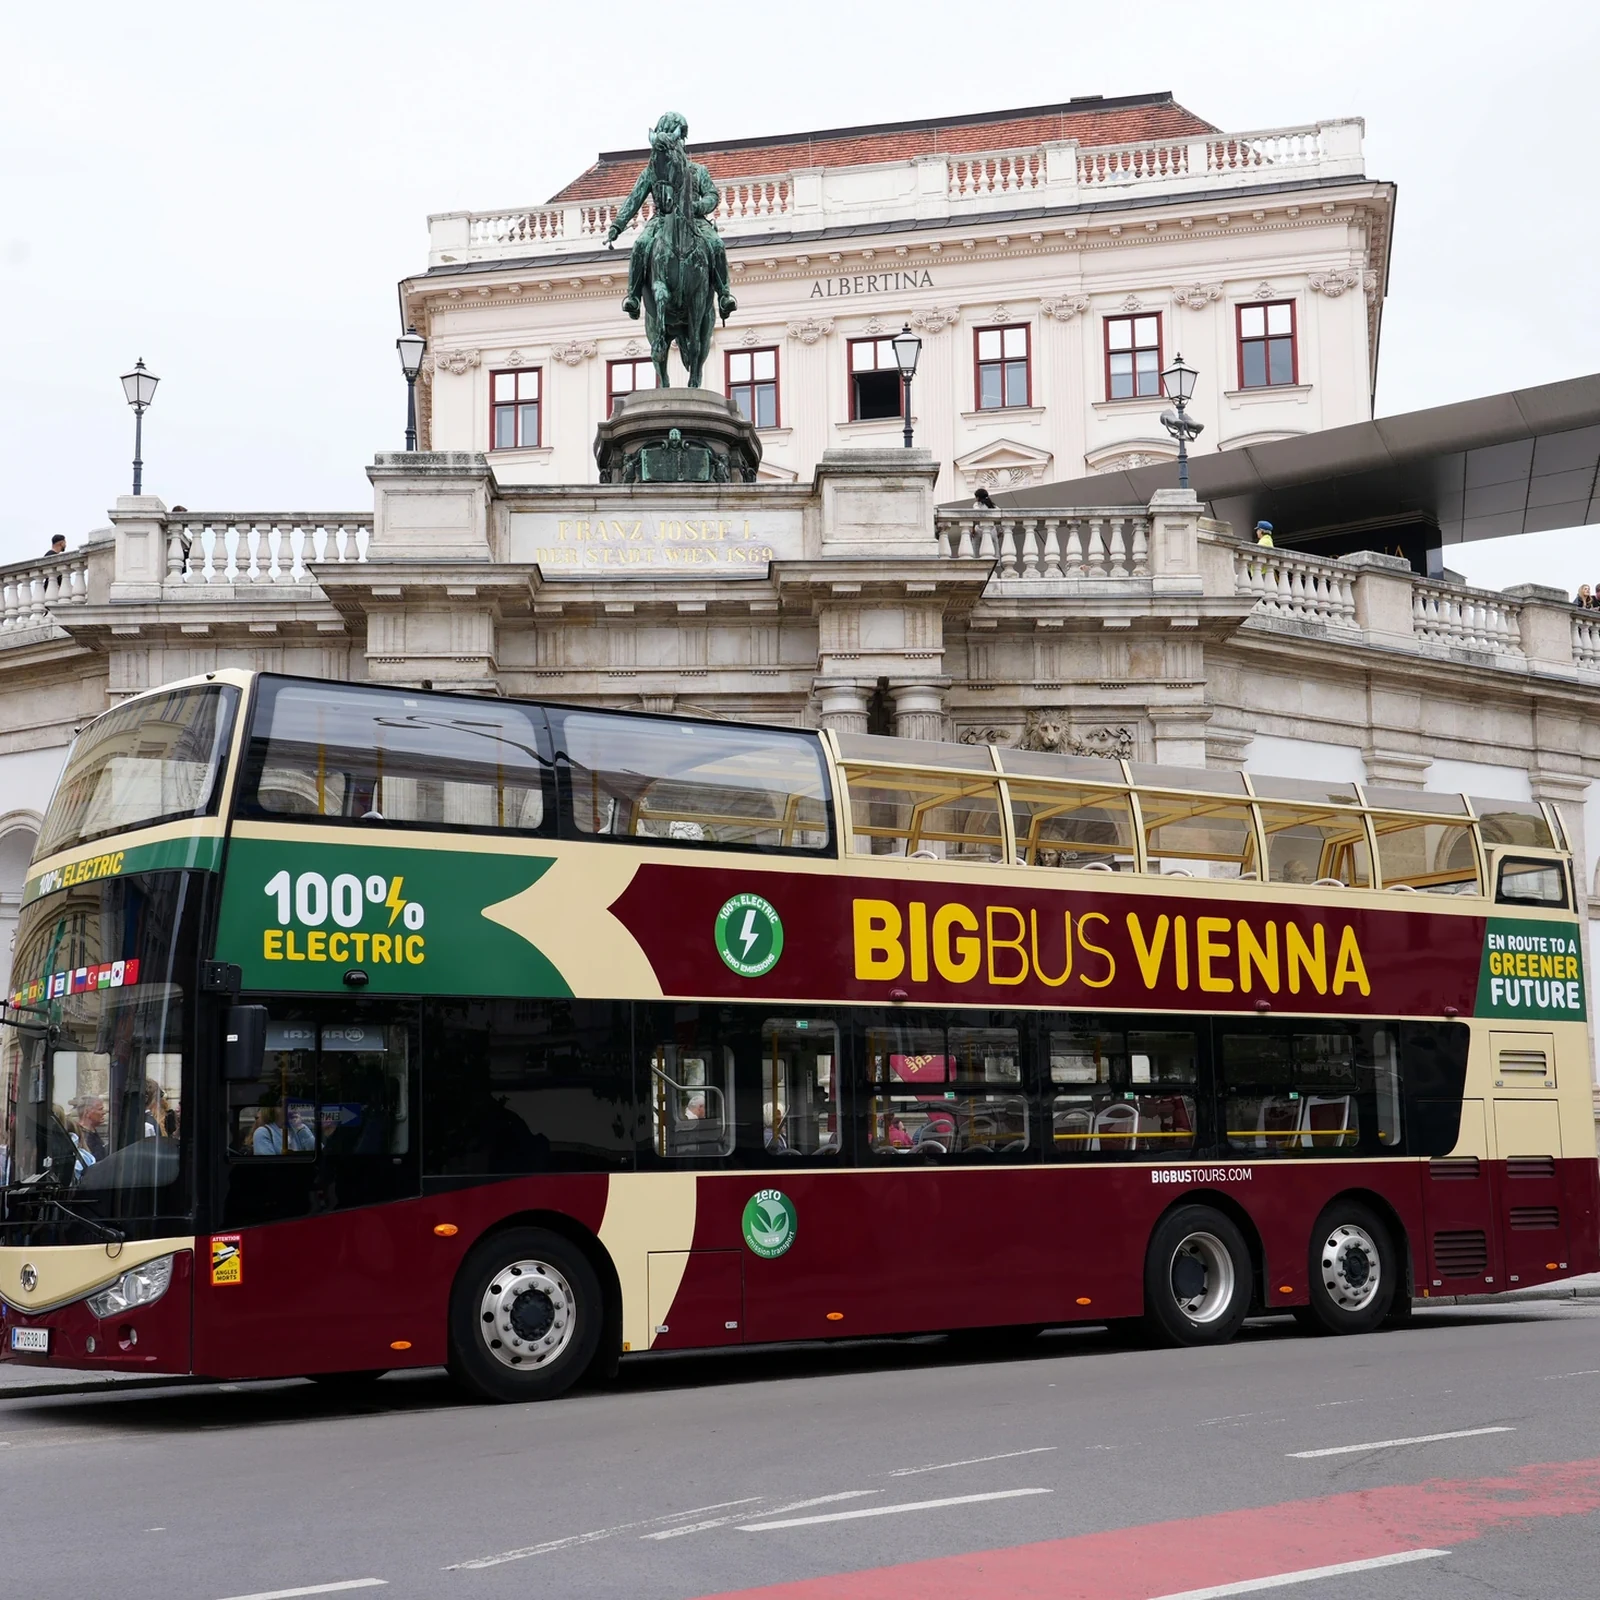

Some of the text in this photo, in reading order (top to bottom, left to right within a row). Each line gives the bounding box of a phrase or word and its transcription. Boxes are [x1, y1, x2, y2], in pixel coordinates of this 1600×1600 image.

[810, 269, 934, 298] ALBERTINA
[557, 519, 643, 541] FRANZ
[653, 519, 732, 541] JOSEF
[536, 546, 774, 564] DER STADT WIEN 1869
[62, 852, 124, 887] ELECTRIC
[264, 870, 424, 930] 100%
[719, 895, 778, 923] 100% ELECTRIC
[264, 929, 425, 964] ELECTRIC
[1126, 912, 1371, 997] VIENNA
[1488, 934, 1577, 954] EN ROUTE TO A
[722, 949, 775, 973] ZERO EMISSIONS
[1489, 952, 1578, 979] GREENER
[1491, 978, 1580, 1009] FUTURE
[1151, 1168, 1252, 1183] BIGBUSTOURS.COM
[755, 1190, 781, 1204] zero
[747, 1231, 794, 1255] emission transport
